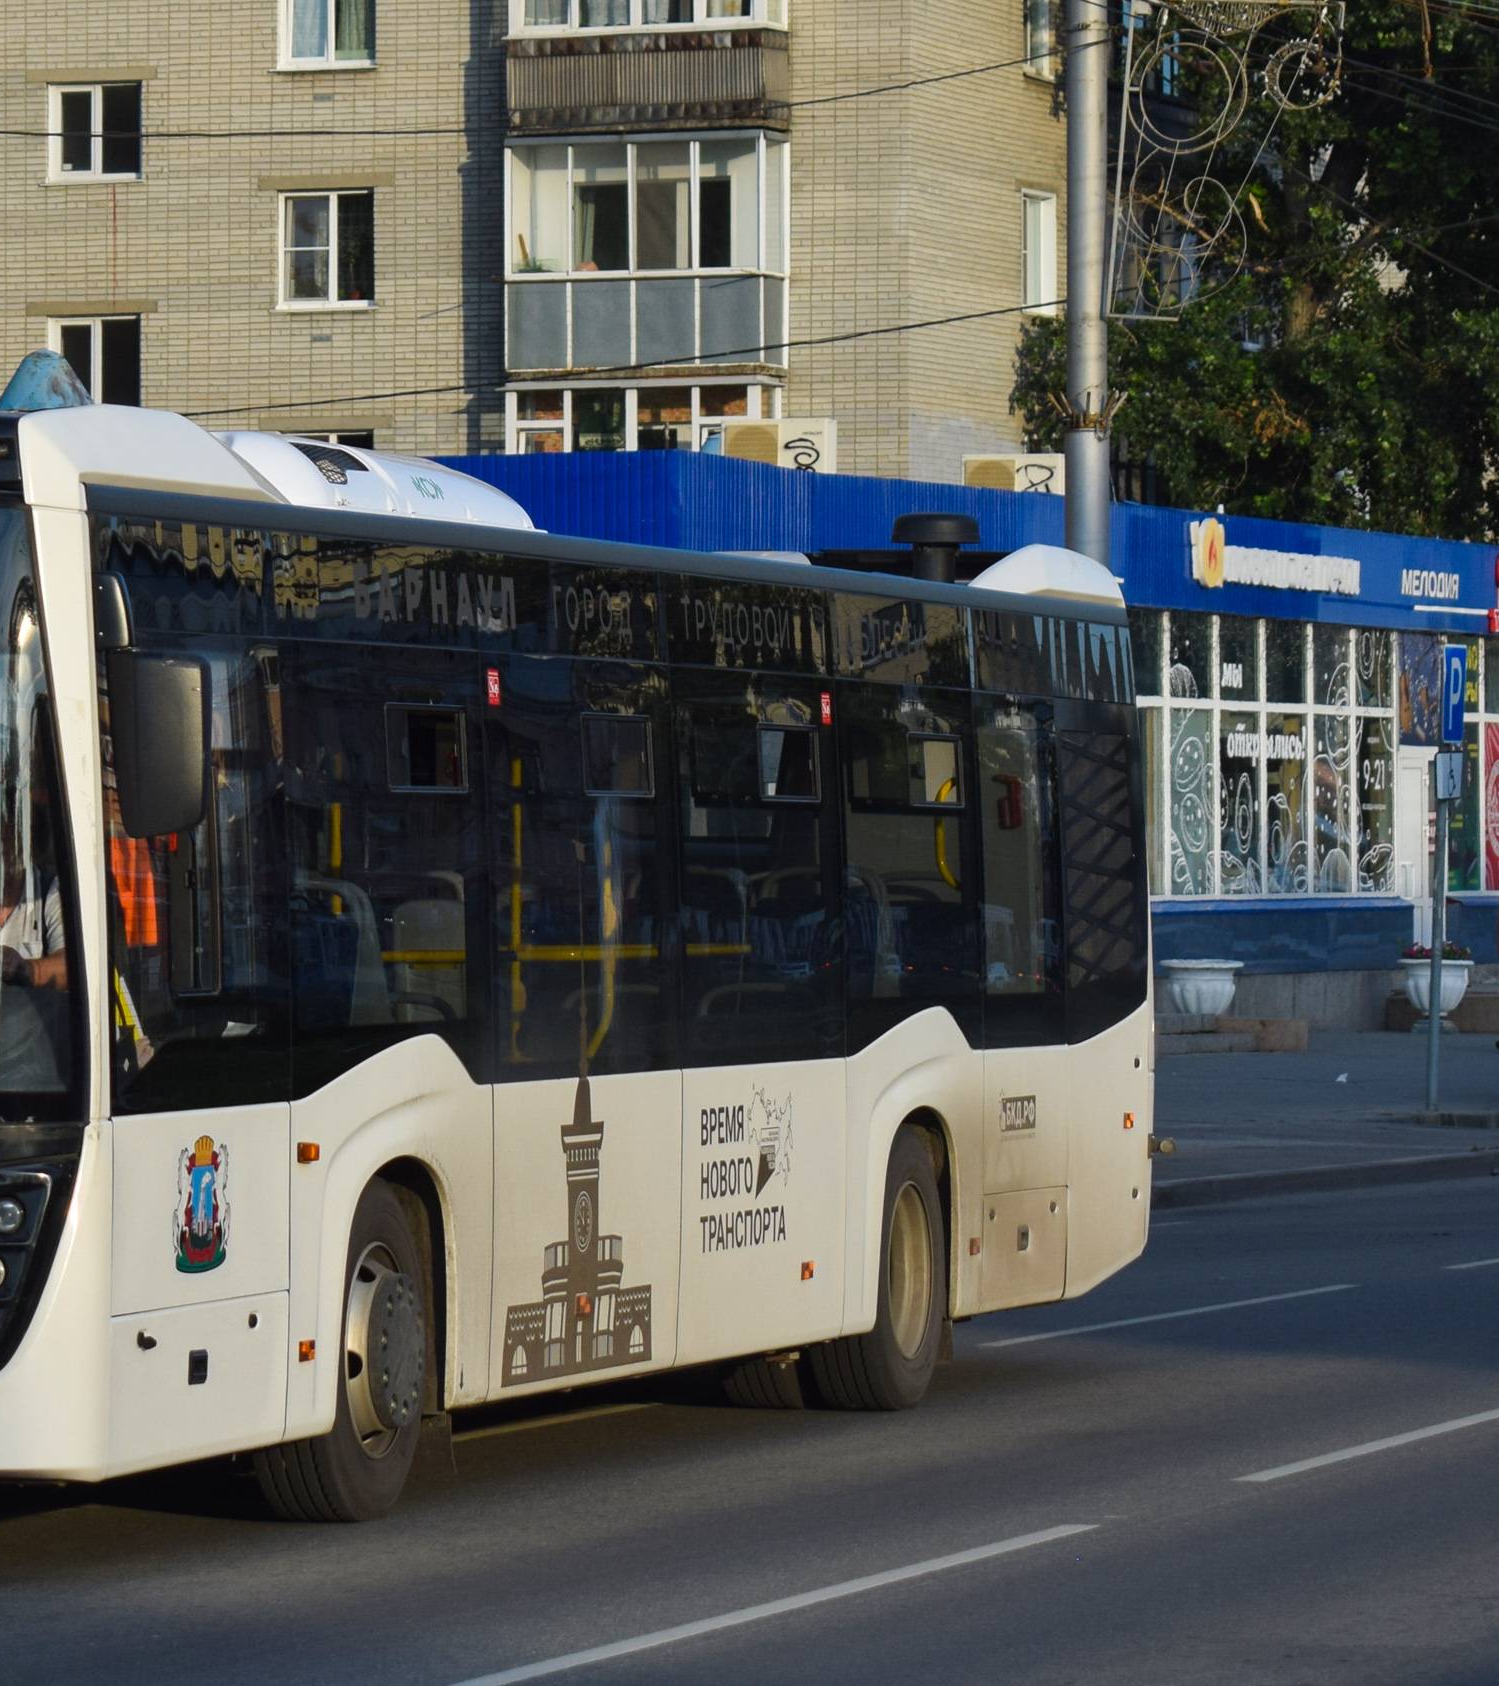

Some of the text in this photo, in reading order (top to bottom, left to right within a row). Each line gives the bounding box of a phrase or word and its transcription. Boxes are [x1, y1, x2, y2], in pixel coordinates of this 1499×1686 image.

[353, 559, 517, 630] БАРНАУЛ
[552, 585, 632, 636] ГОРОД
[681, 597, 791, 651] ТРУДОВОЙ
[1401, 569, 1459, 600] МЕЛОДИЯ
[701, 1105, 744, 1146] ВРЕМЯ
[700, 1157, 753, 1200] НОВОГО
[700, 1205, 786, 1254] ТРАНСПОРТА
